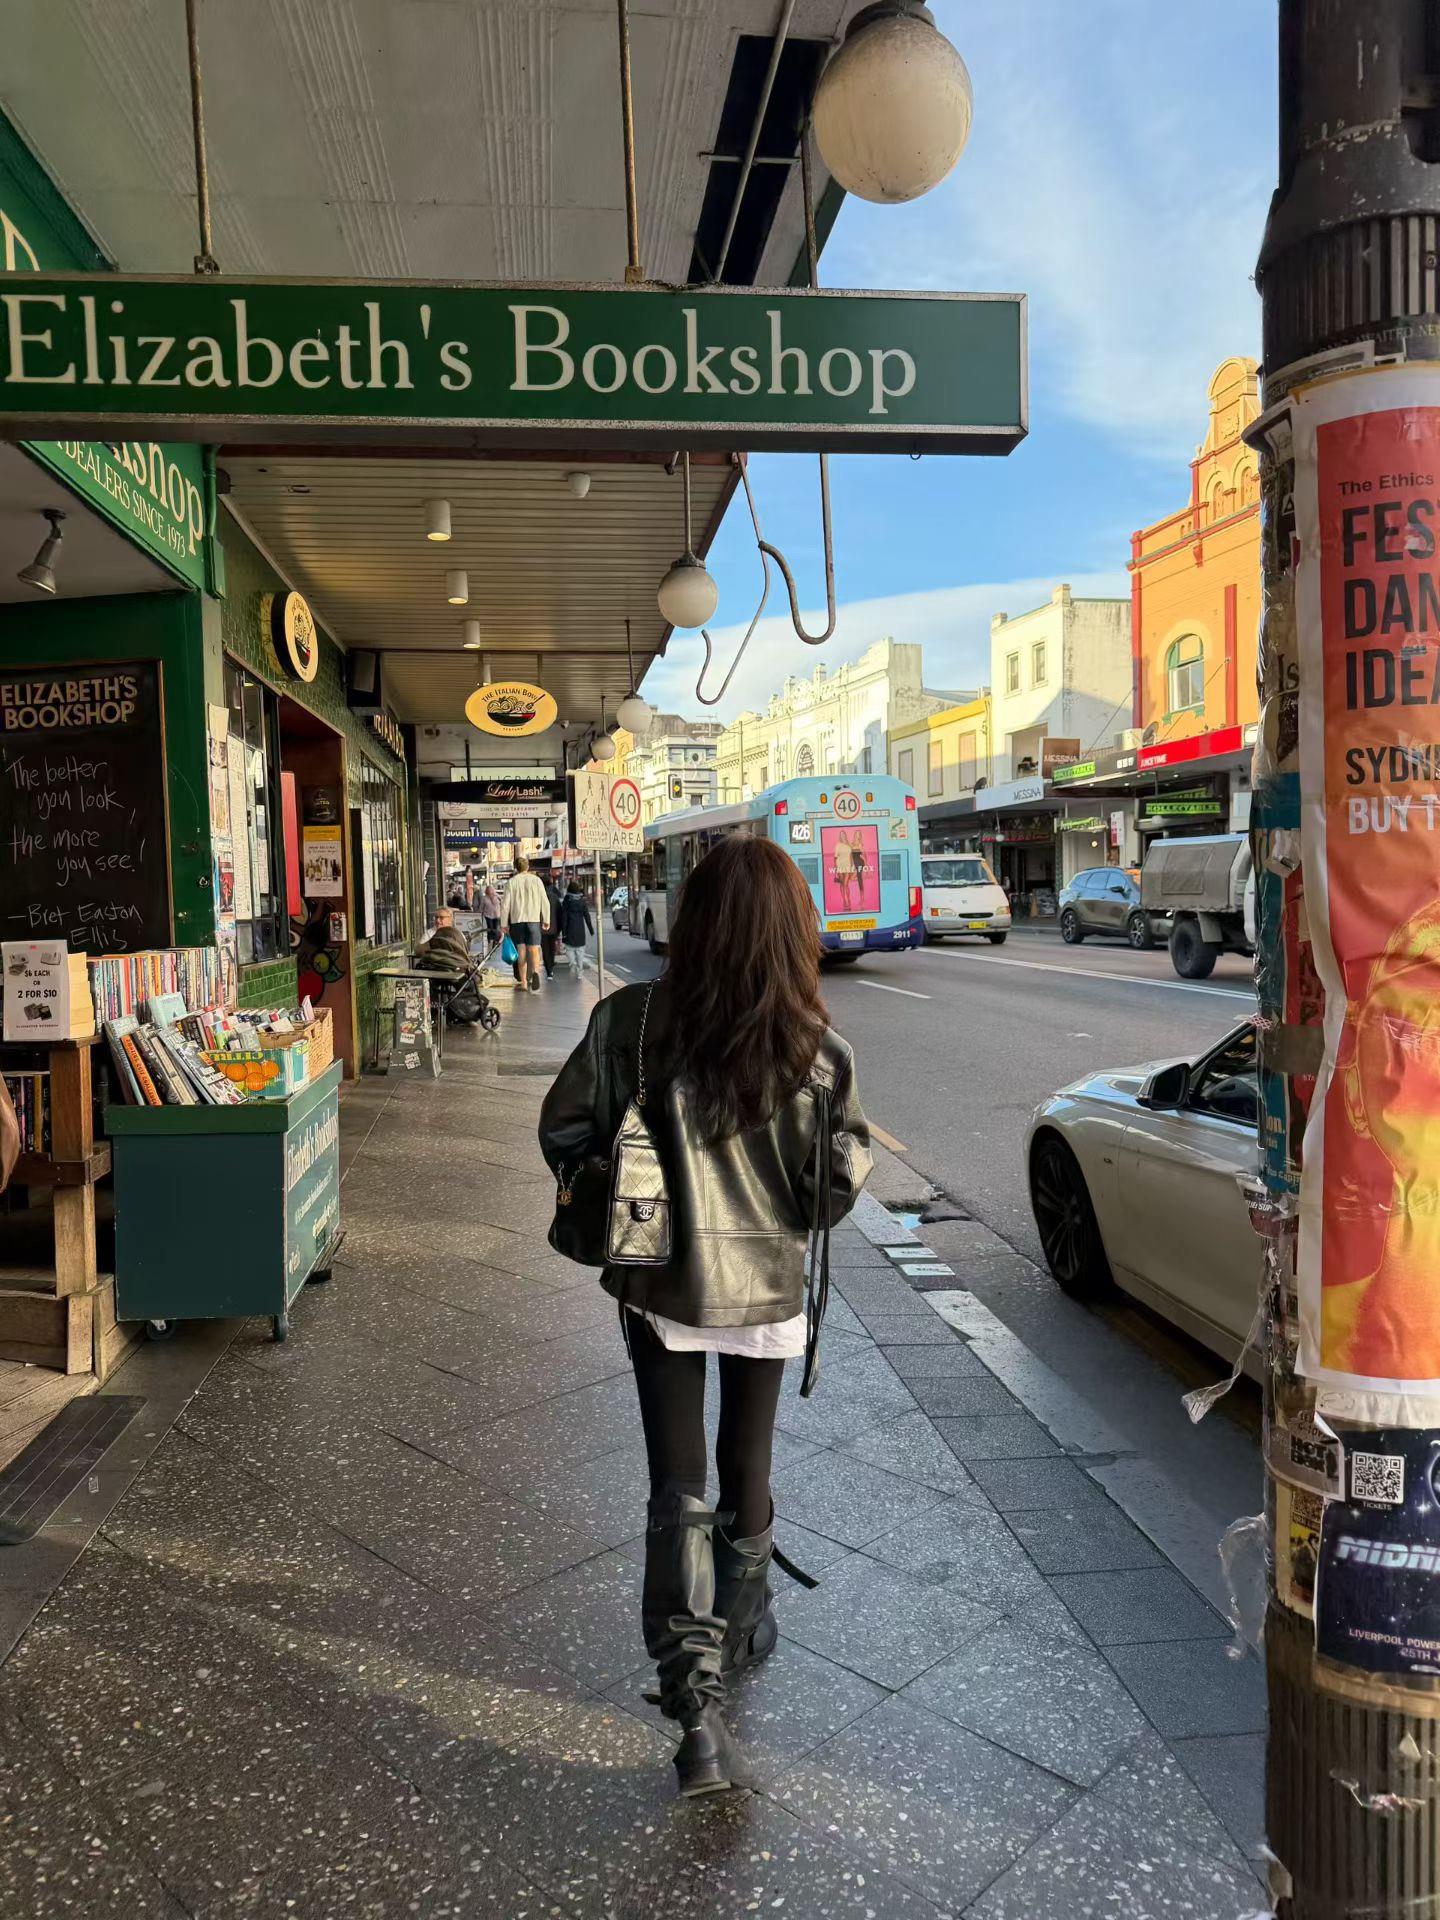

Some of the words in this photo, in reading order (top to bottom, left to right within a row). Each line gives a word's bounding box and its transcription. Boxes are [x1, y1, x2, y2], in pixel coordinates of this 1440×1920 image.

[2, 293, 473, 392] Elizabeth's
[508, 305, 917, 414] Bookshop
[1338, 480, 1372, 496] The
[1380, 472, 1434, 490] Ethics
[132, 489, 166, 542] SINCE
[167, 523, 186, 558] 1973
[1342, 499, 1440, 568] FES
[1, 675, 138, 707] ELIZABETH'S
[481, 691, 494, 703] THE
[4, 702, 135, 729] BOOKSHOP
[44, 755, 108, 786] better
[487, 783, 516, 800] Lady
[1013, 787, 1042, 801] MESSINA
[37, 790, 72, 820] you
[616, 792, 637, 815] 40
[837, 798, 858, 813] 40
[1349, 795, 1412, 834] BUY
[612, 831, 643, 846] AREA
[792, 824, 811, 841] 426
[9, 825, 47, 865] the
[53, 829, 101, 852] more
[57, 855, 93, 887] you
[858, 865, 875, 873] FOX
[78, 902, 144, 926] Easton
[70, 926, 127, 951] Ellis
[893, 930, 911, 939] 2911
[34, 969, 51, 977] EACH
[18, 989, 23, 999] 2
[25, 989, 42, 999] FOR
[43, 988, 57, 998] $10
[1363, 1501, 1393, 1511] TICKETS
[1349, 1627, 1404, 1646] LIVERPOOL
